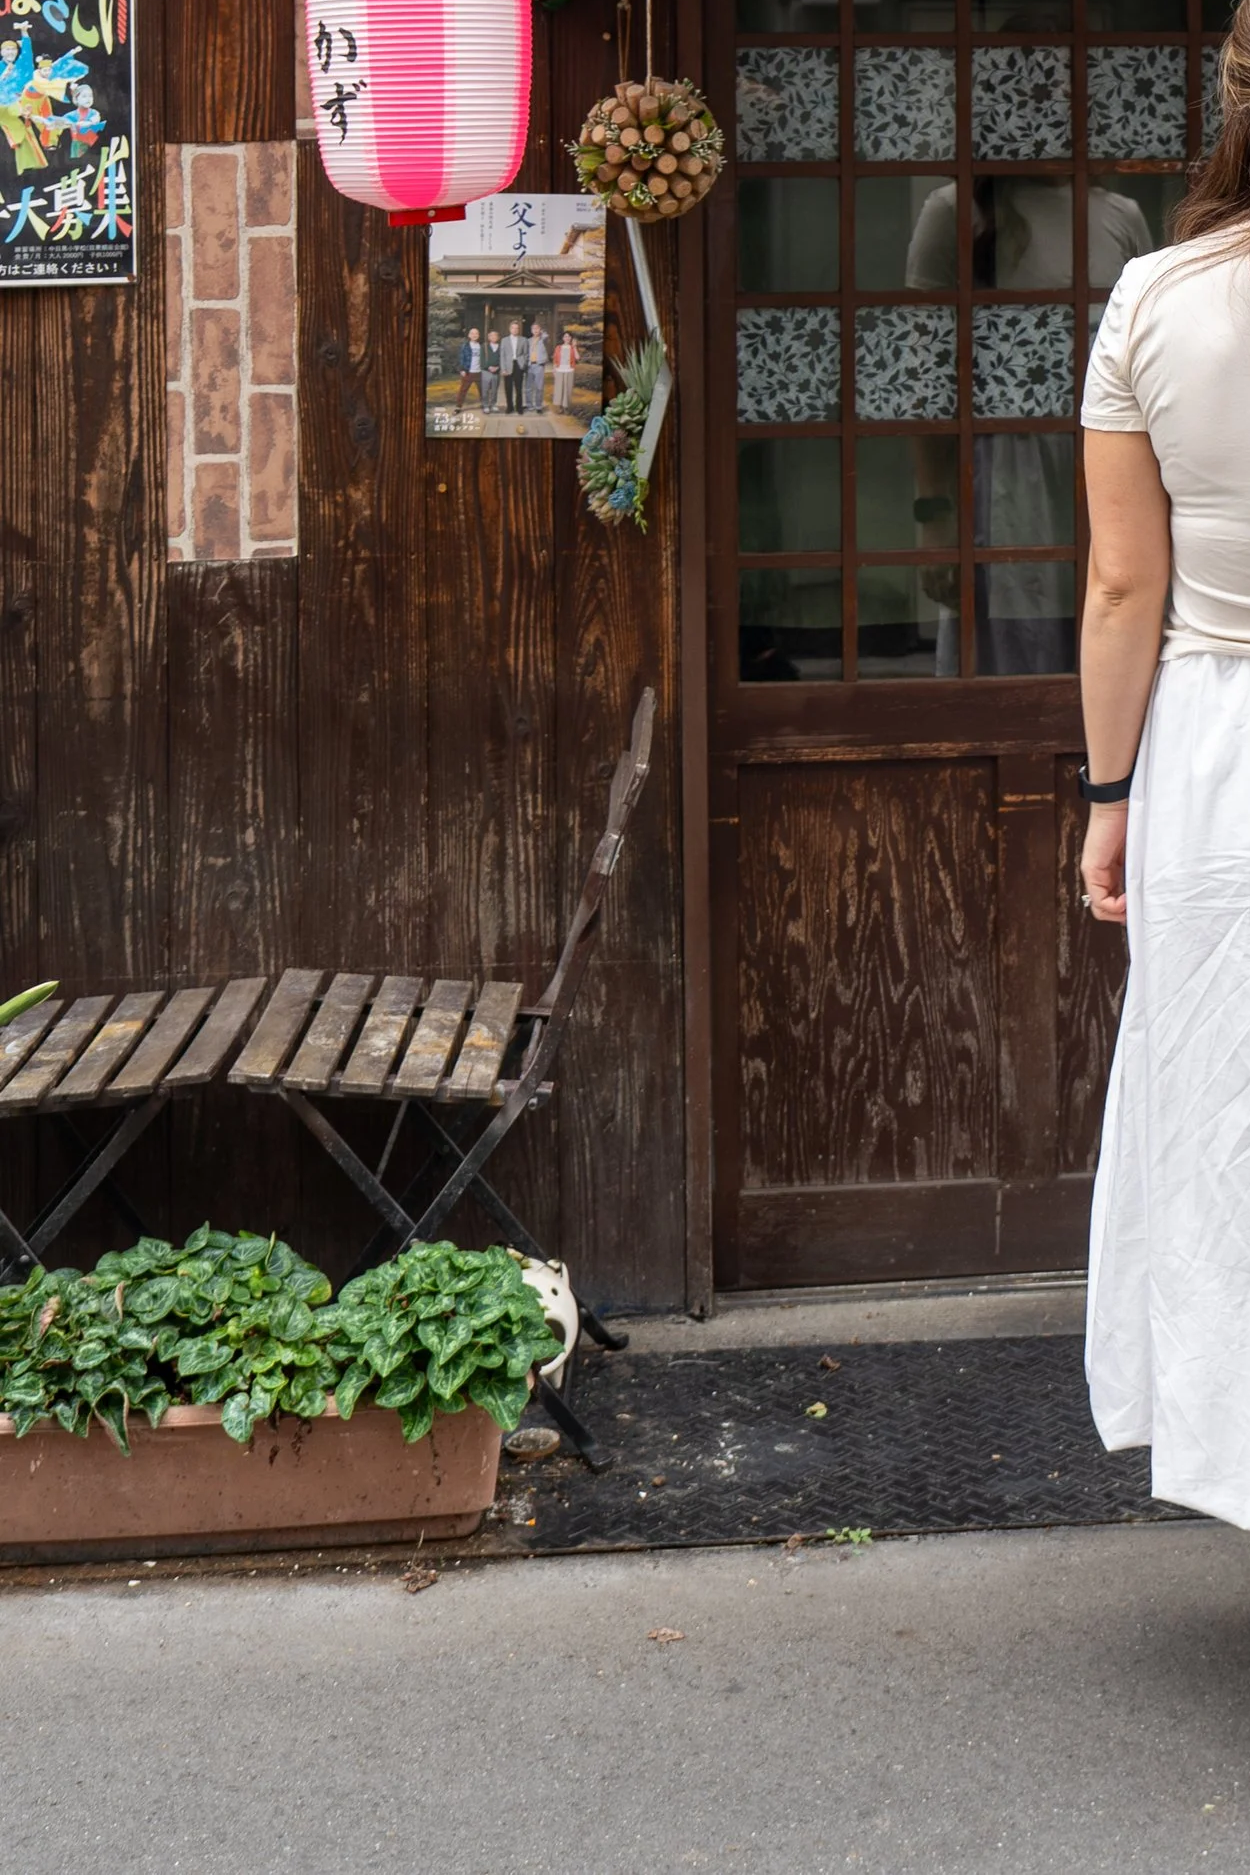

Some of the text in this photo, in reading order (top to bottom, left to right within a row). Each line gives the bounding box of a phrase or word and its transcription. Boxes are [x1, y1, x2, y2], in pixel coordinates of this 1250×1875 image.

[313, 19, 367, 146] かず
[0, 134, 132, 243] 大募集
